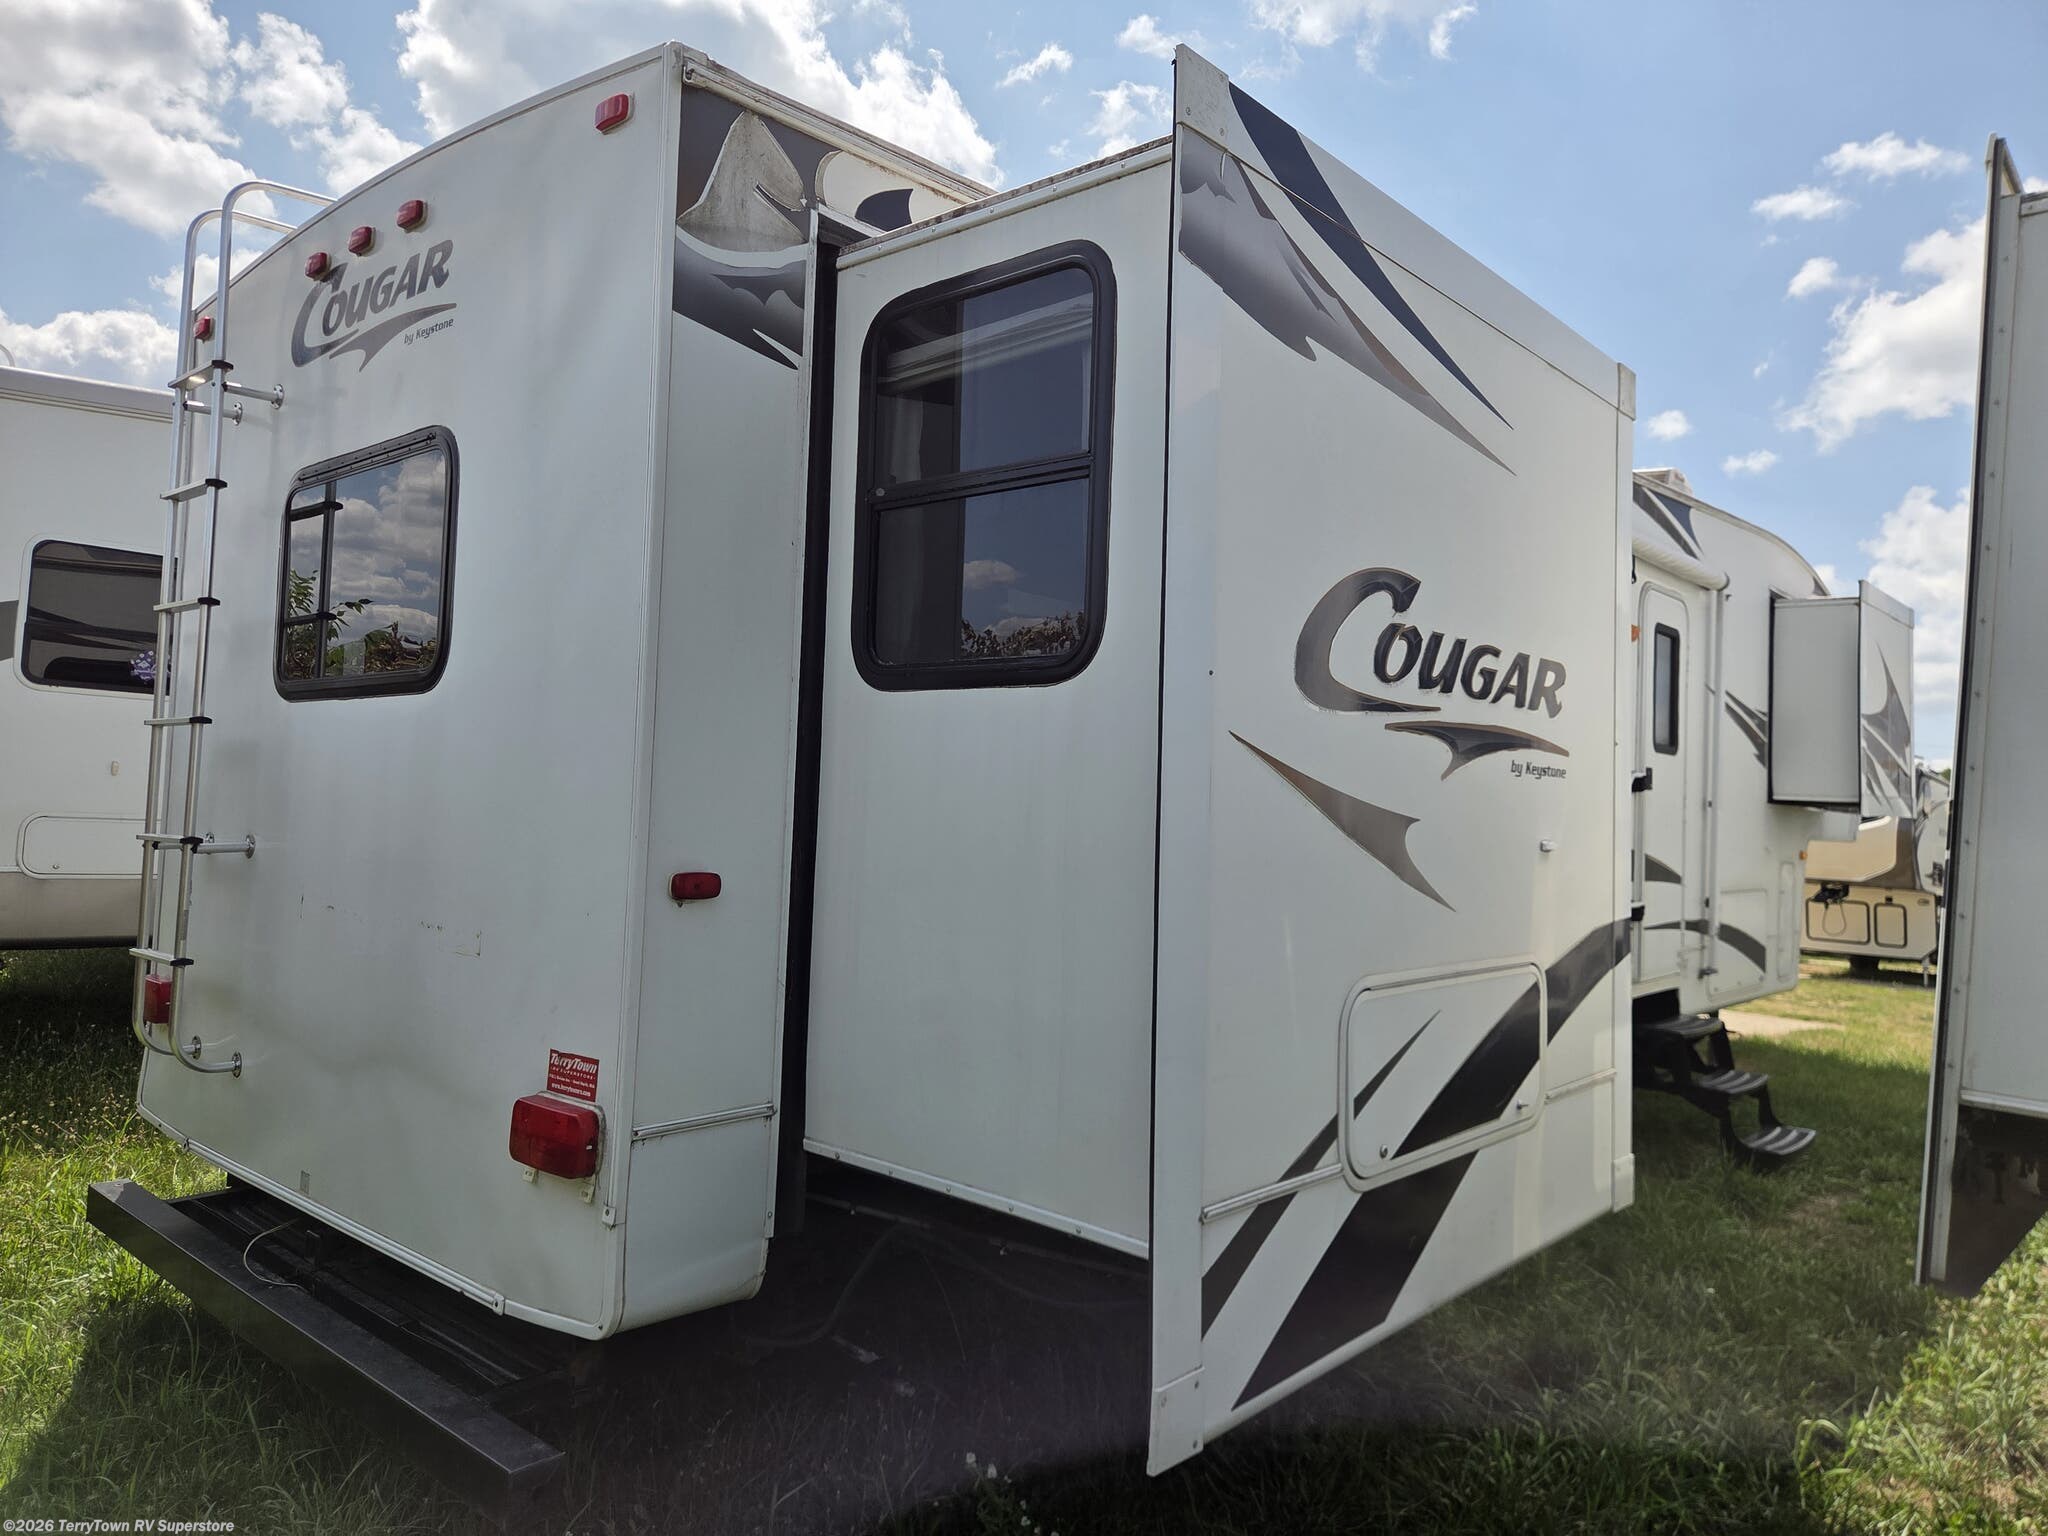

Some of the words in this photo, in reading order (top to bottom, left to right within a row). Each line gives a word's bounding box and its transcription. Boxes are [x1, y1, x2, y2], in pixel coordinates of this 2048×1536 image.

[291, 240, 454, 367] COUGAR
[404, 332, 414, 346] by
[416, 319, 454, 341] Keystone
[1294, 567, 1567, 719] COUGAR
[1510, 760, 1523, 778] by
[1525, 761, 1567, 780] Keystone
[550, 1052, 597, 1074] TerryTown
